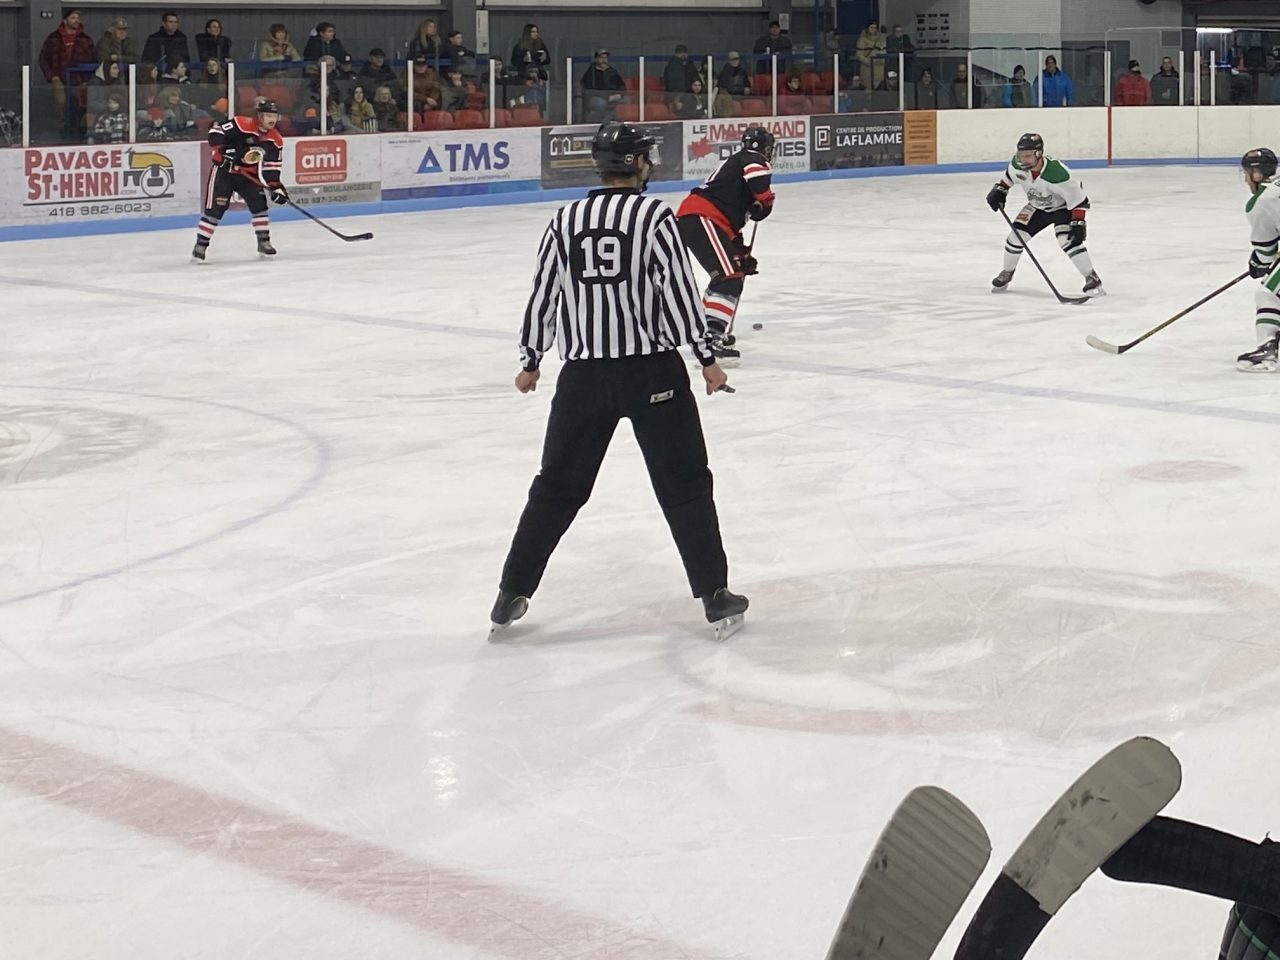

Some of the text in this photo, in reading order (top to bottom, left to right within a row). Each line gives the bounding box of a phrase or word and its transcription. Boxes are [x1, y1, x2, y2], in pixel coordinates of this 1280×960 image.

[693, 121, 806, 142] LE MARHAND
[836, 133, 903, 148] LAFLAMME
[25, 149, 122, 176] PAVAGE
[302, 146, 341, 169] ami
[445, 141, 510, 172] TMS
[49, 202, 152, 217] 418 882-6023
[581, 236, 621, 277] 19
